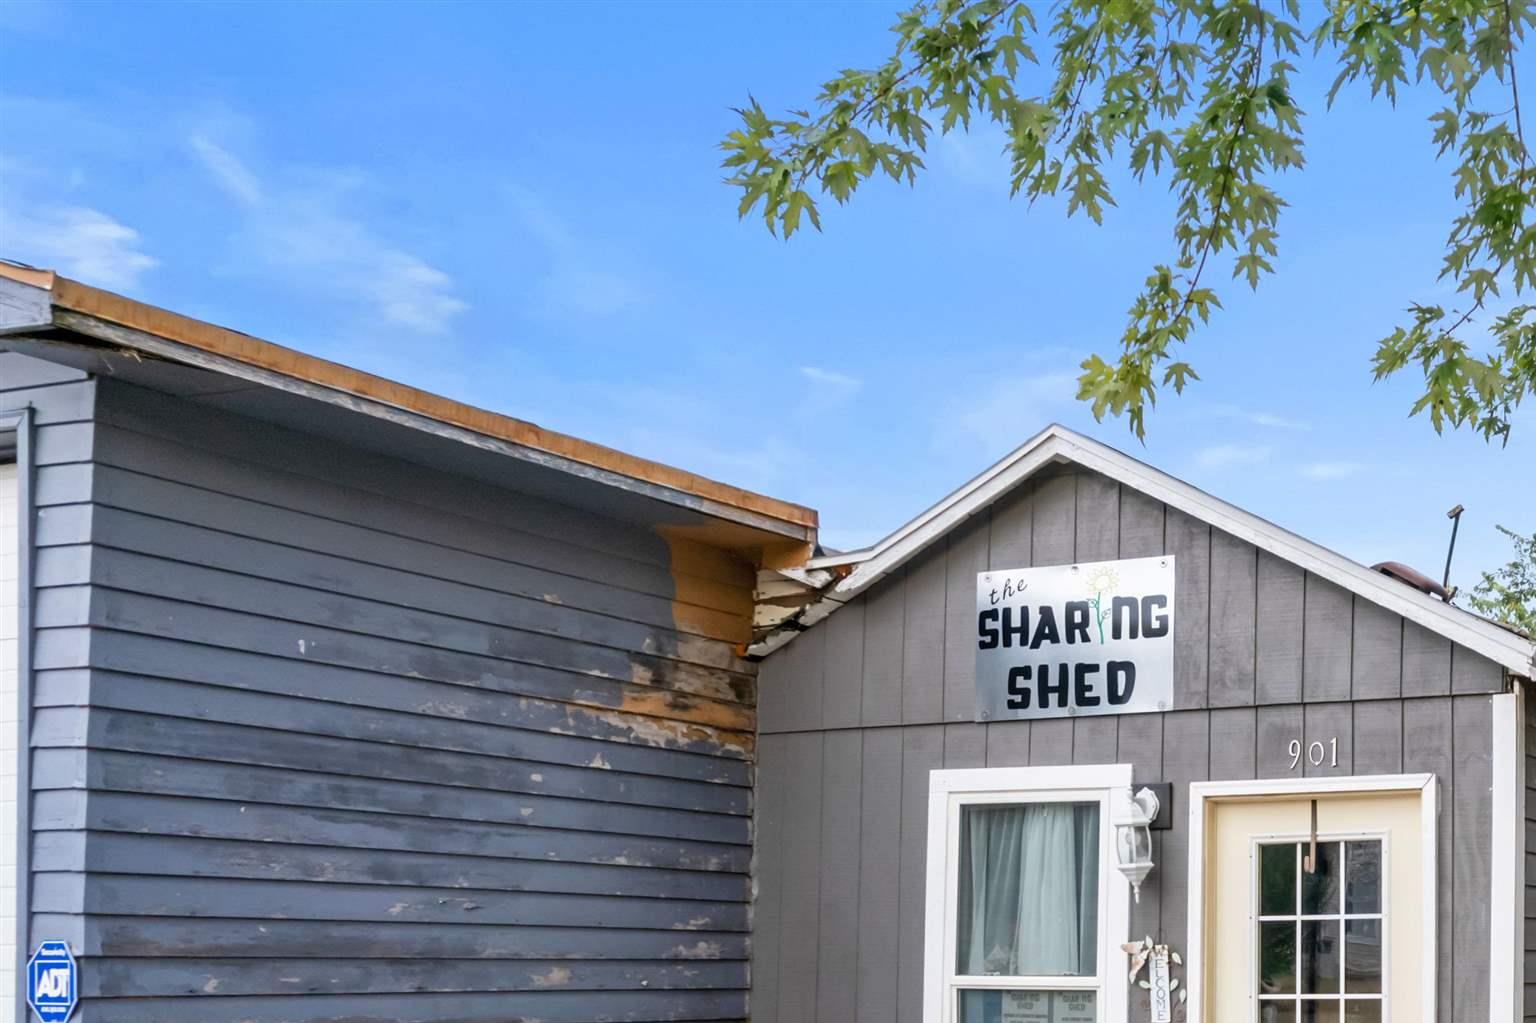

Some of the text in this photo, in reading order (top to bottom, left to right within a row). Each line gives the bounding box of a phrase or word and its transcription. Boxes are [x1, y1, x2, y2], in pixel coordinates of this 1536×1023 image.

[988, 577, 1028, 605] the
[1007, 660, 1136, 710] SHED
[1288, 737, 1338, 769] 901
[36, 968, 70, 998] ADT
[1155, 949, 1166, 1021] ELCOME
